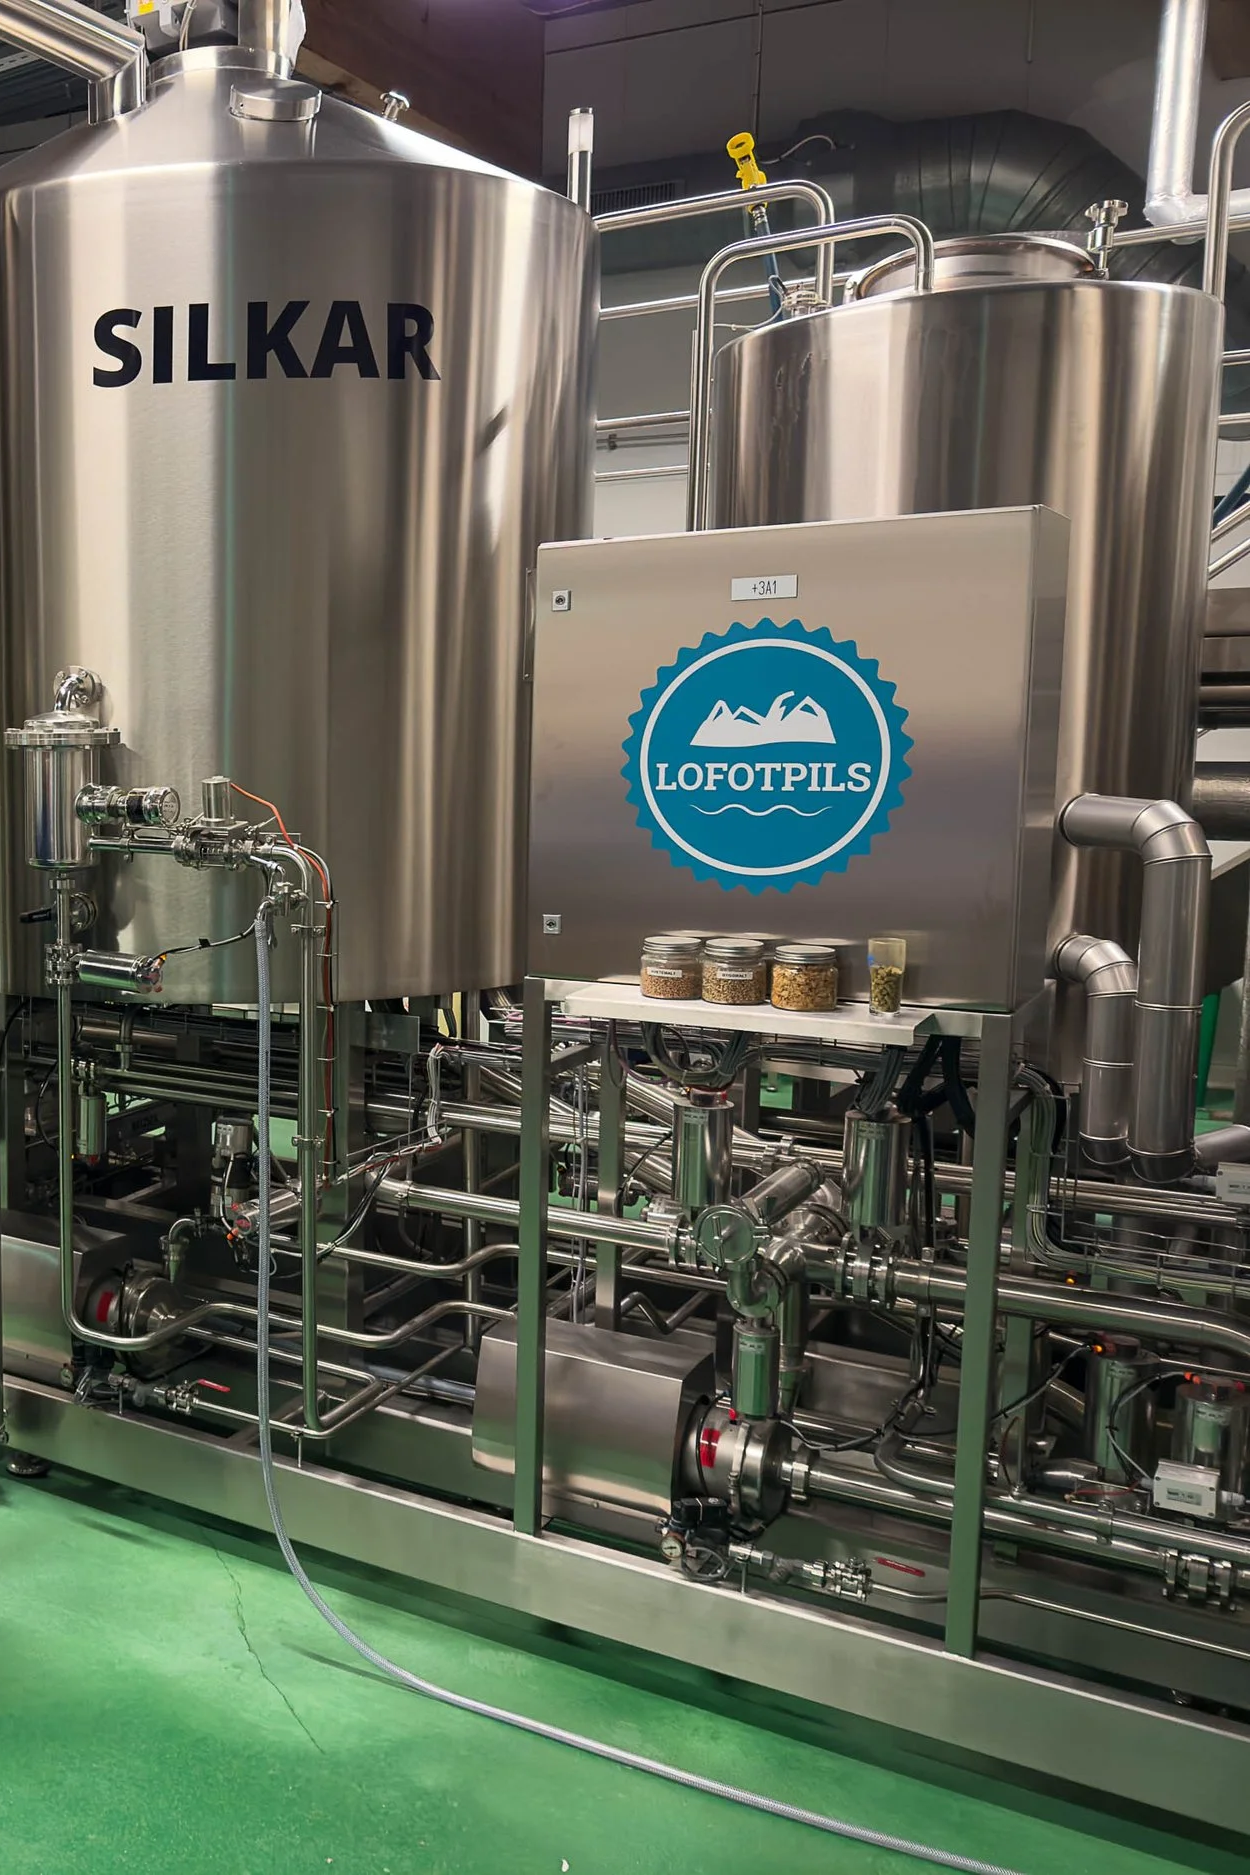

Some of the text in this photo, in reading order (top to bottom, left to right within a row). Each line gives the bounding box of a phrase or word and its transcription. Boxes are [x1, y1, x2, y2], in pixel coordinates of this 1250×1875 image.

[93, 300, 442, 388] SILKAR
[751, 579, 778, 596] +3A1
[655, 762, 872, 793] LOFOTPILS
